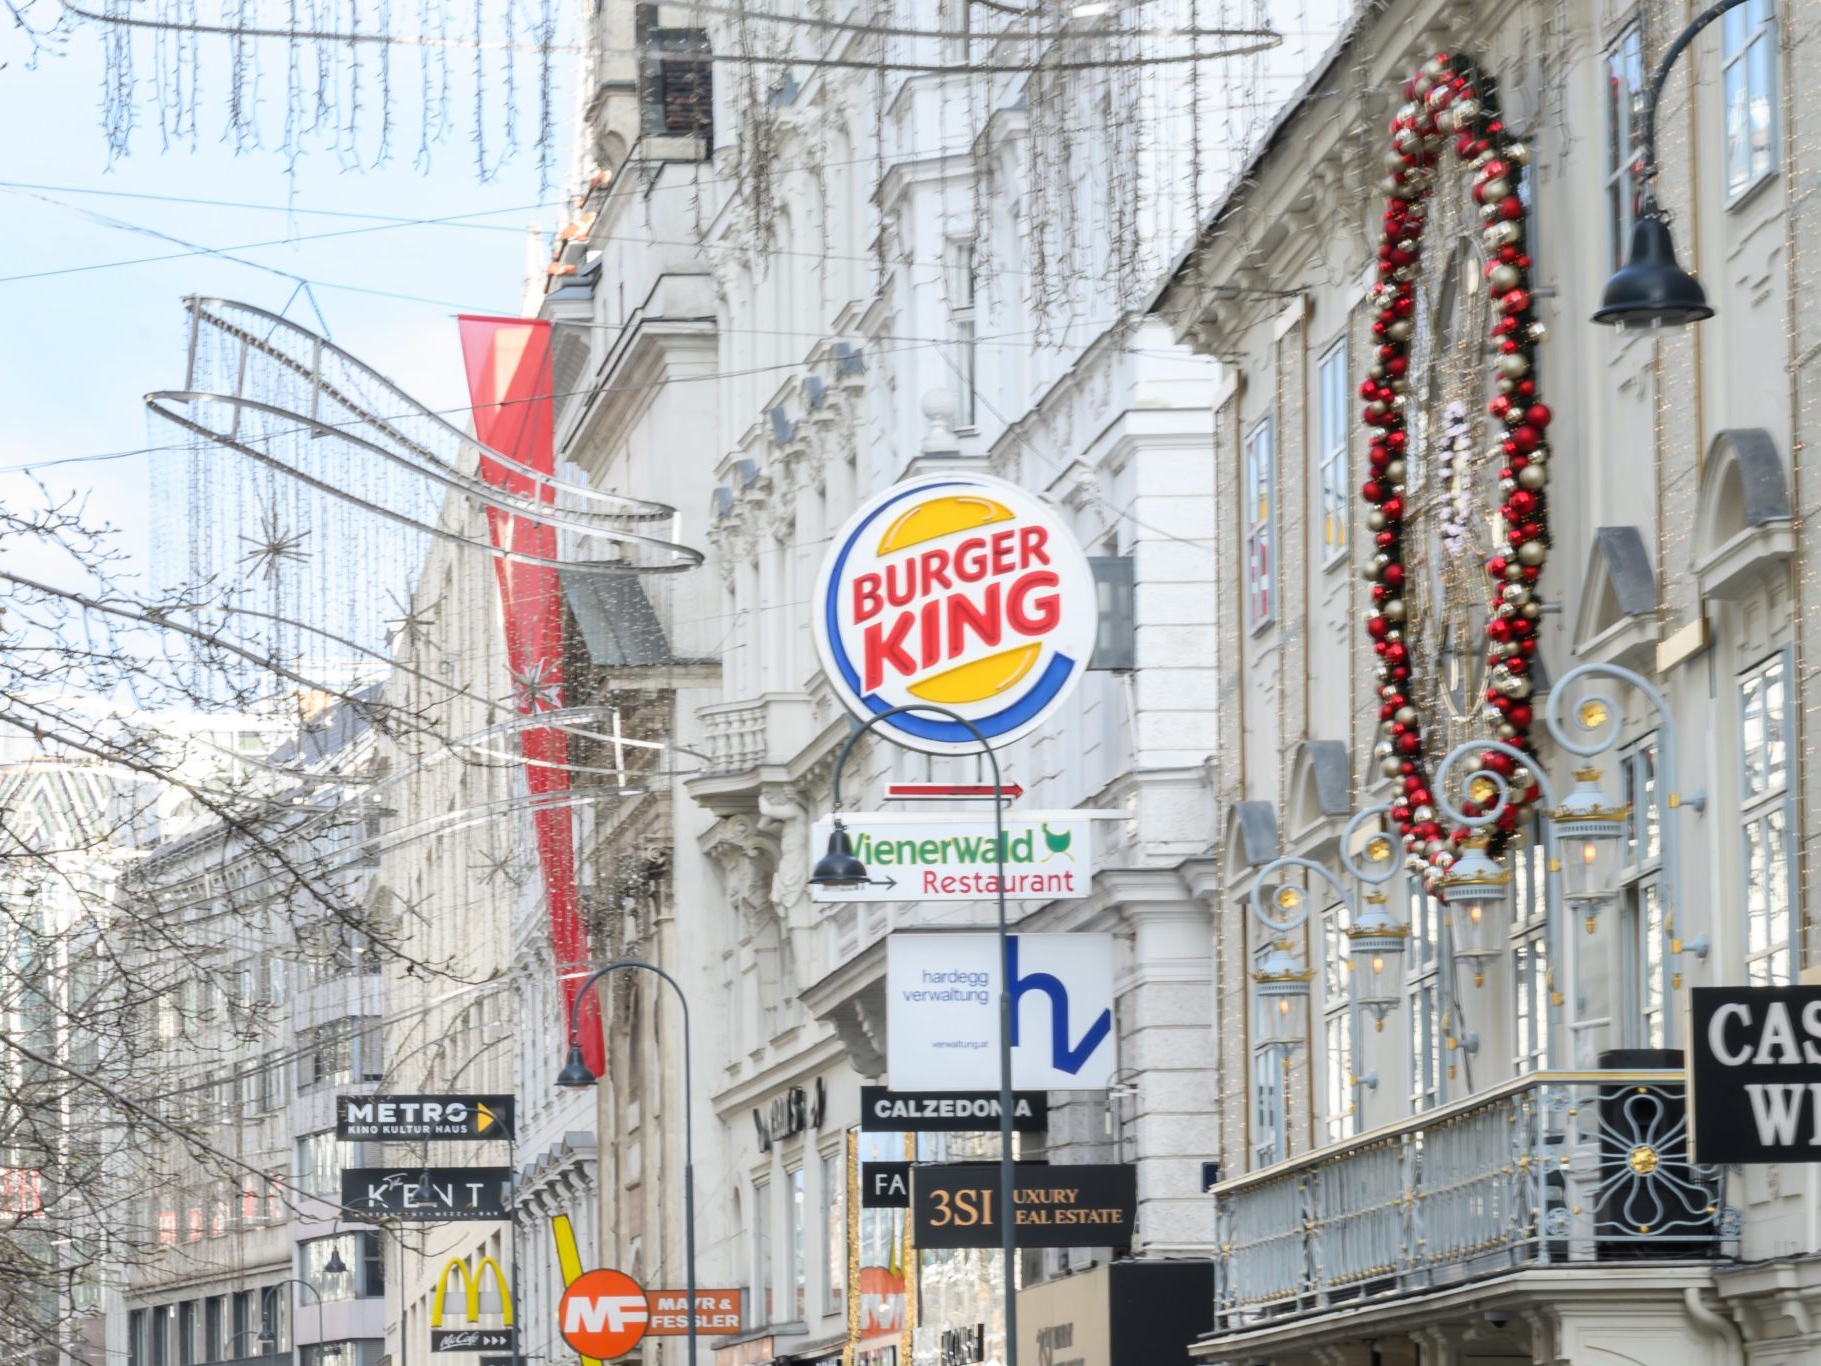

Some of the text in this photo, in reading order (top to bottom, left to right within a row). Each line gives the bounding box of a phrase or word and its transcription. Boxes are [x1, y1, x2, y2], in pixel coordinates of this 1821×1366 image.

[852, 524, 1051, 626] BURGER
[863, 569, 1061, 693] KING
[923, 870, 1074, 894] Restaurant
[922, 969, 989, 986] hardegg
[902, 987, 989, 1005] verwaltung
[347, 1102, 469, 1124] METRO
[874, 1099, 1033, 1119] CALZEDONA
[347, 1124, 469, 1135] KINO KULTUR HAUS
[367, 1183, 484, 1209] KENT
[1011, 1189, 1079, 1204] UXURY
[1014, 1209, 1123, 1225] EAL ESTATE
[564, 1296, 649, 1334] MF
[651, 1314, 739, 1329] FESSLER
